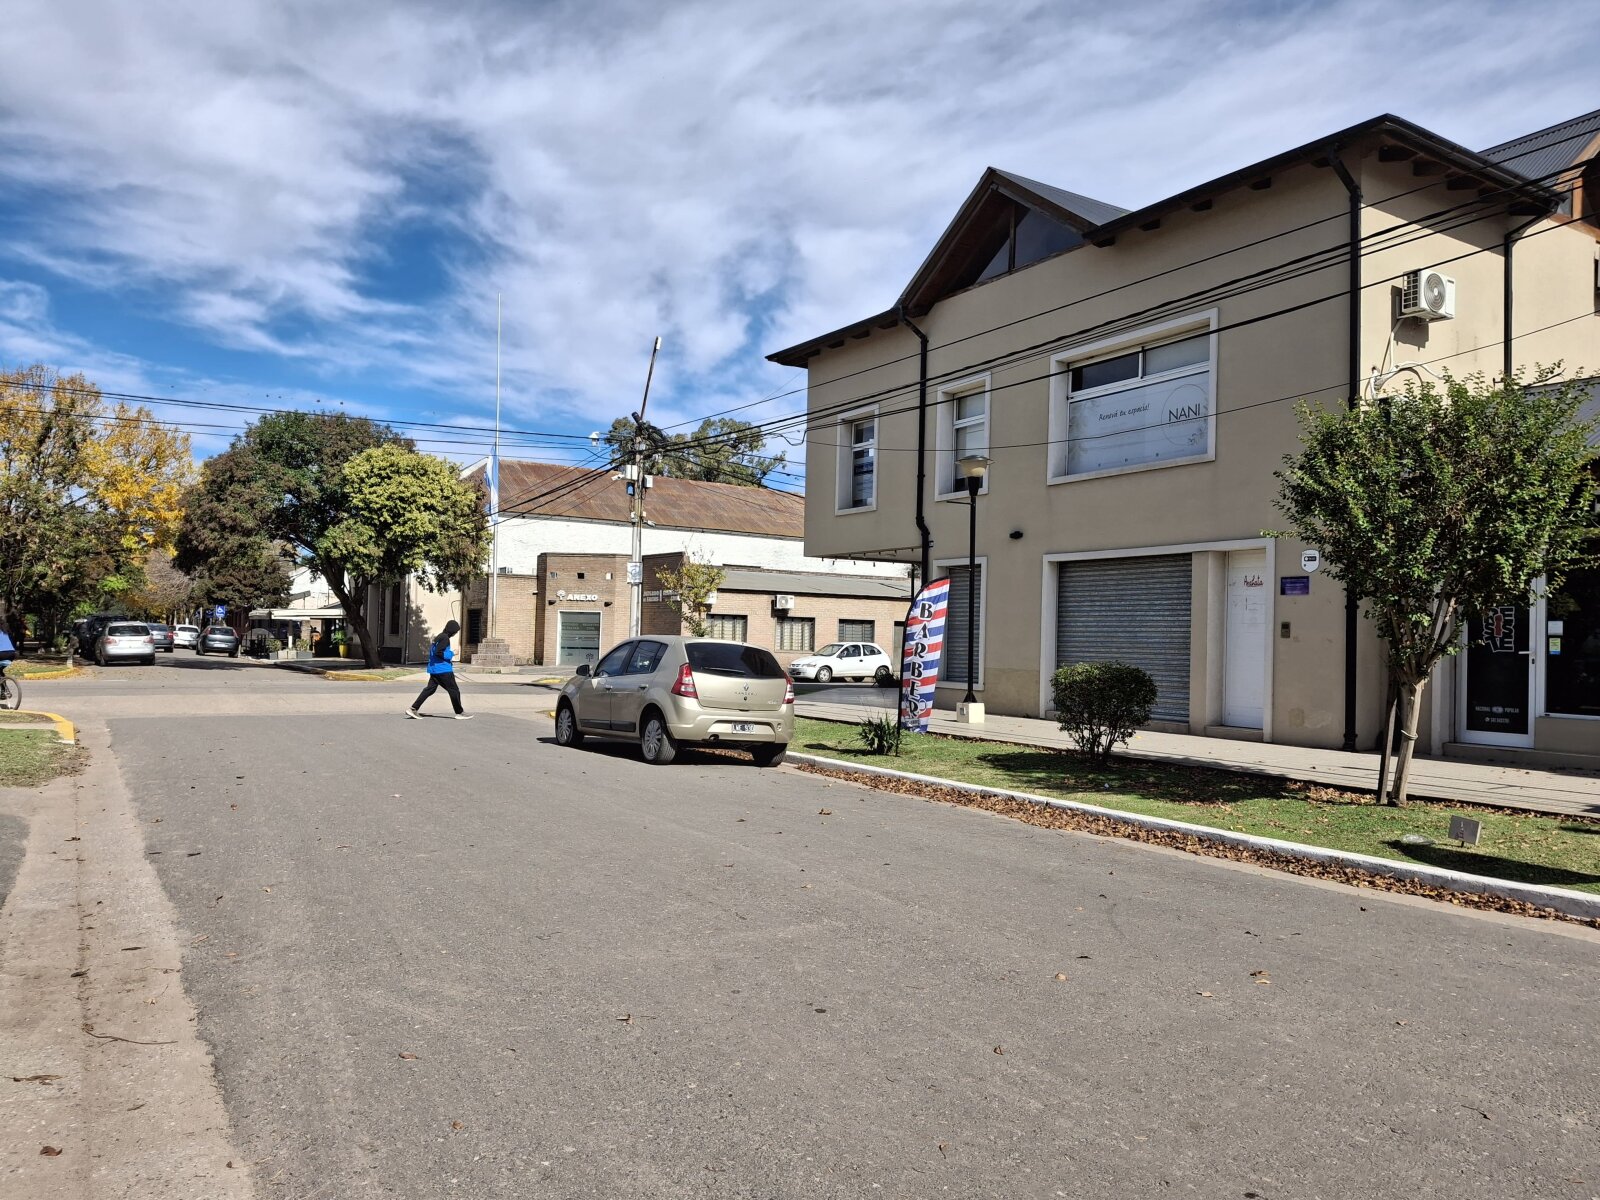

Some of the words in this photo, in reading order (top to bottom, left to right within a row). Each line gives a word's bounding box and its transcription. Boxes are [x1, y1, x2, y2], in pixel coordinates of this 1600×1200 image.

[1168, 403, 1200, 422] NANI
[566, 593, 598, 602] ANEXO
[908, 601, 934, 719] BARBER
